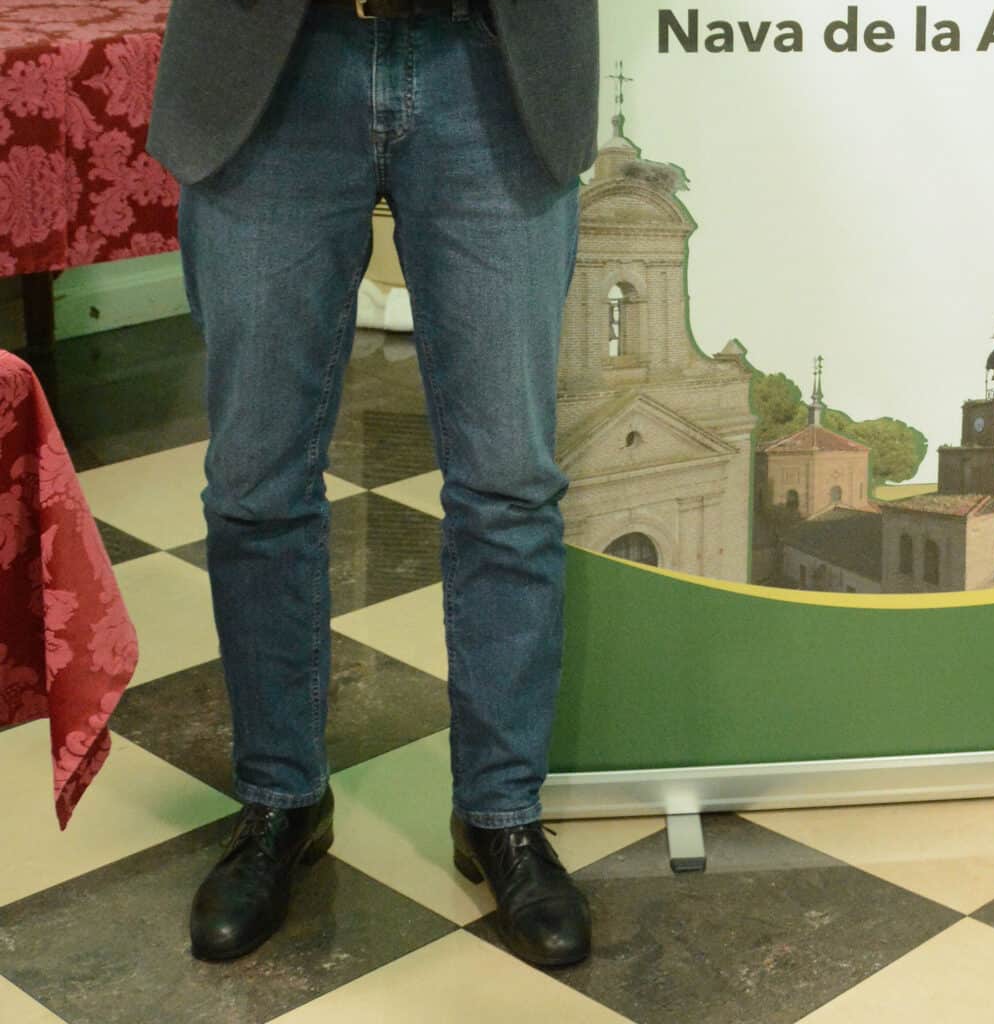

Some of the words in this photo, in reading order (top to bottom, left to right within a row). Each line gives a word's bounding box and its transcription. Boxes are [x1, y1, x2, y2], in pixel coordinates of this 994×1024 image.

[658, 8, 803, 54] Nava
[823, 5, 895, 53] de
[915, 5, 960, 52] la
